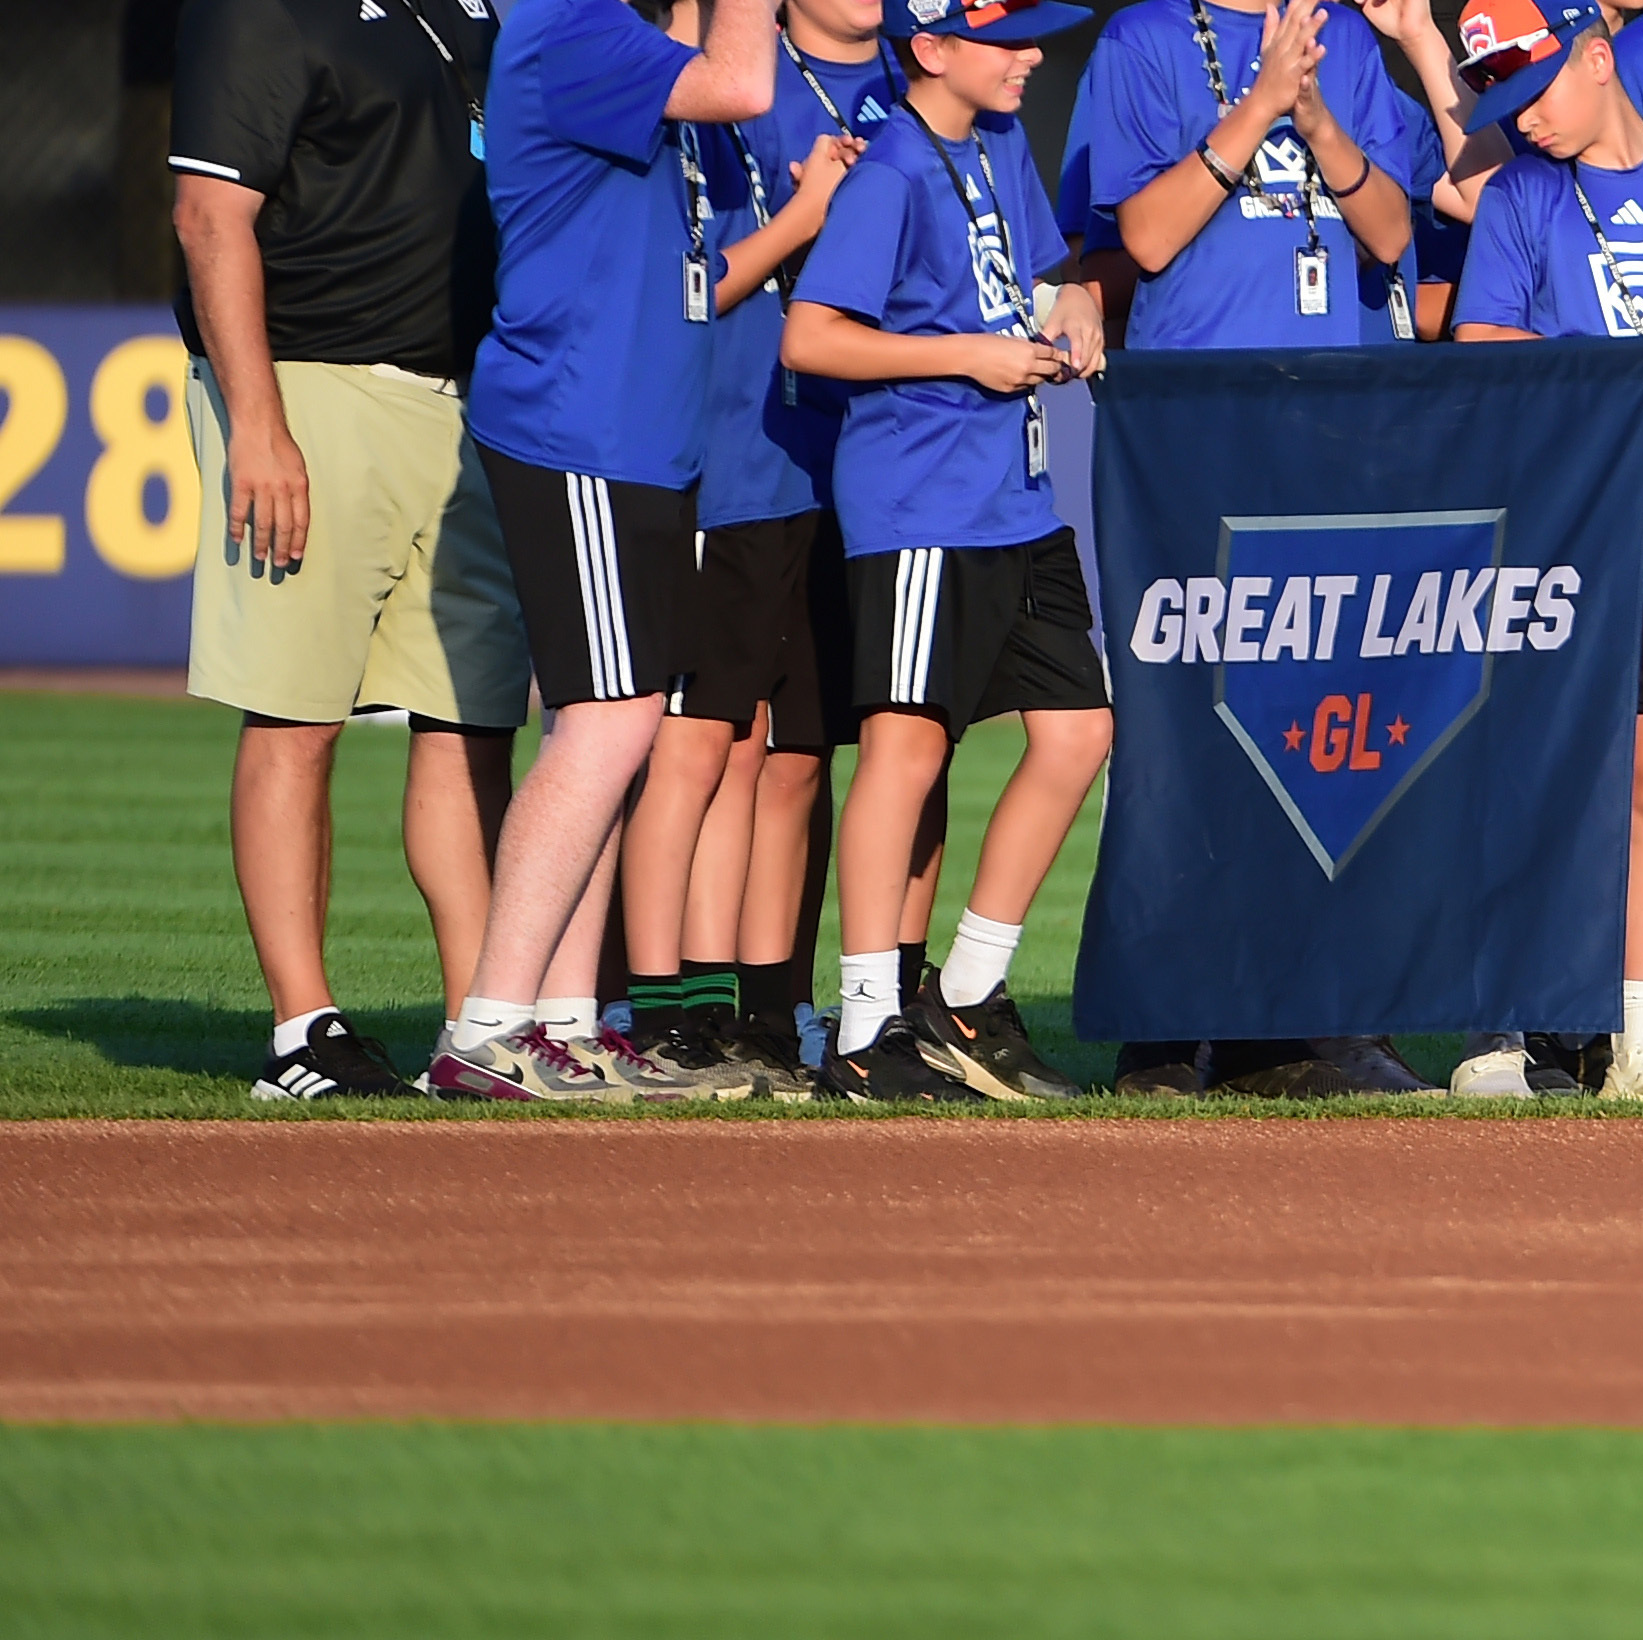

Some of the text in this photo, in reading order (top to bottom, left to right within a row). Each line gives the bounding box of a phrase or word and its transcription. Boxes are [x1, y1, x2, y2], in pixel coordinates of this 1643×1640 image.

[1130, 565, 1582, 663] GREAT LAKES
[1308, 693, 1382, 773] GL
